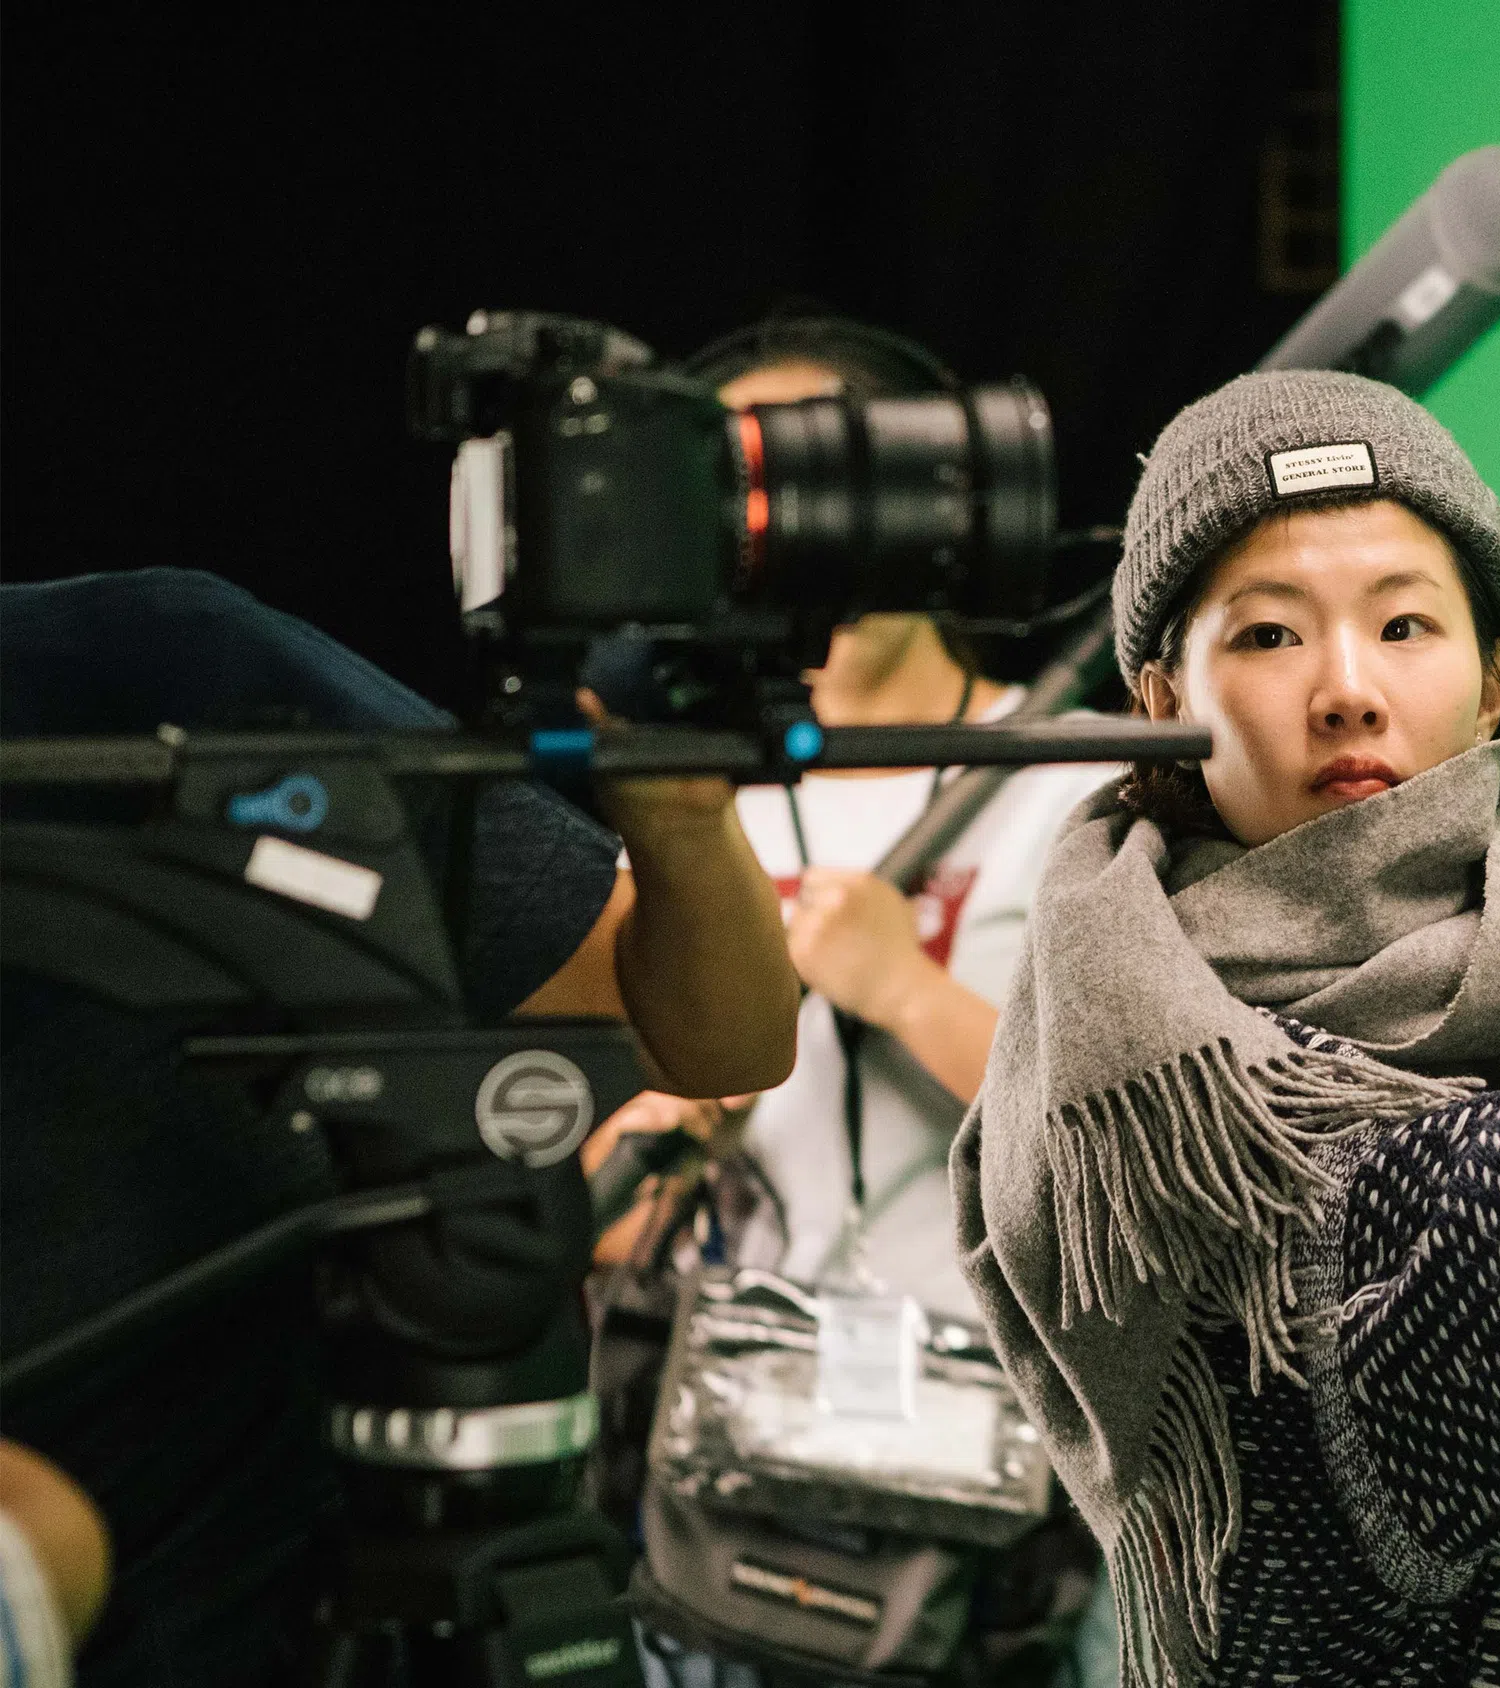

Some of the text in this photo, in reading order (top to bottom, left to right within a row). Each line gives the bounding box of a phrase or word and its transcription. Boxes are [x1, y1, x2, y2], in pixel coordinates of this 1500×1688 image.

[1285, 457, 1322, 468] STUSSY
[1282, 464, 1366, 481] GENERAL STORE
